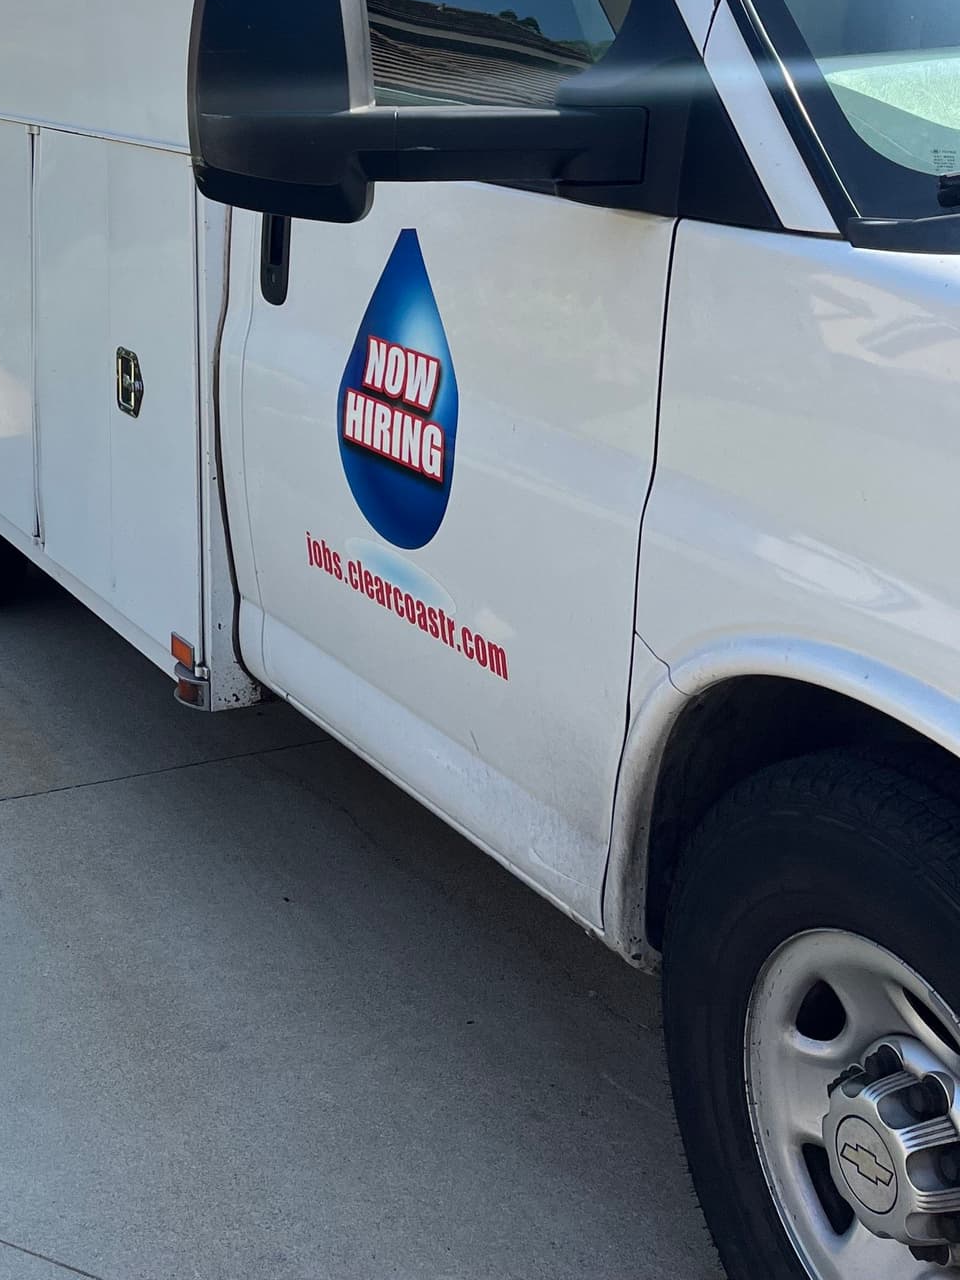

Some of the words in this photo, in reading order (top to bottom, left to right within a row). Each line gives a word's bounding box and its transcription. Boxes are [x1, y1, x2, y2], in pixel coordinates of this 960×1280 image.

[363, 336, 439, 411] NOW
[344, 389, 444, 481] HIRING
[305, 531, 509, 681] jobs.clearcoastr.com
